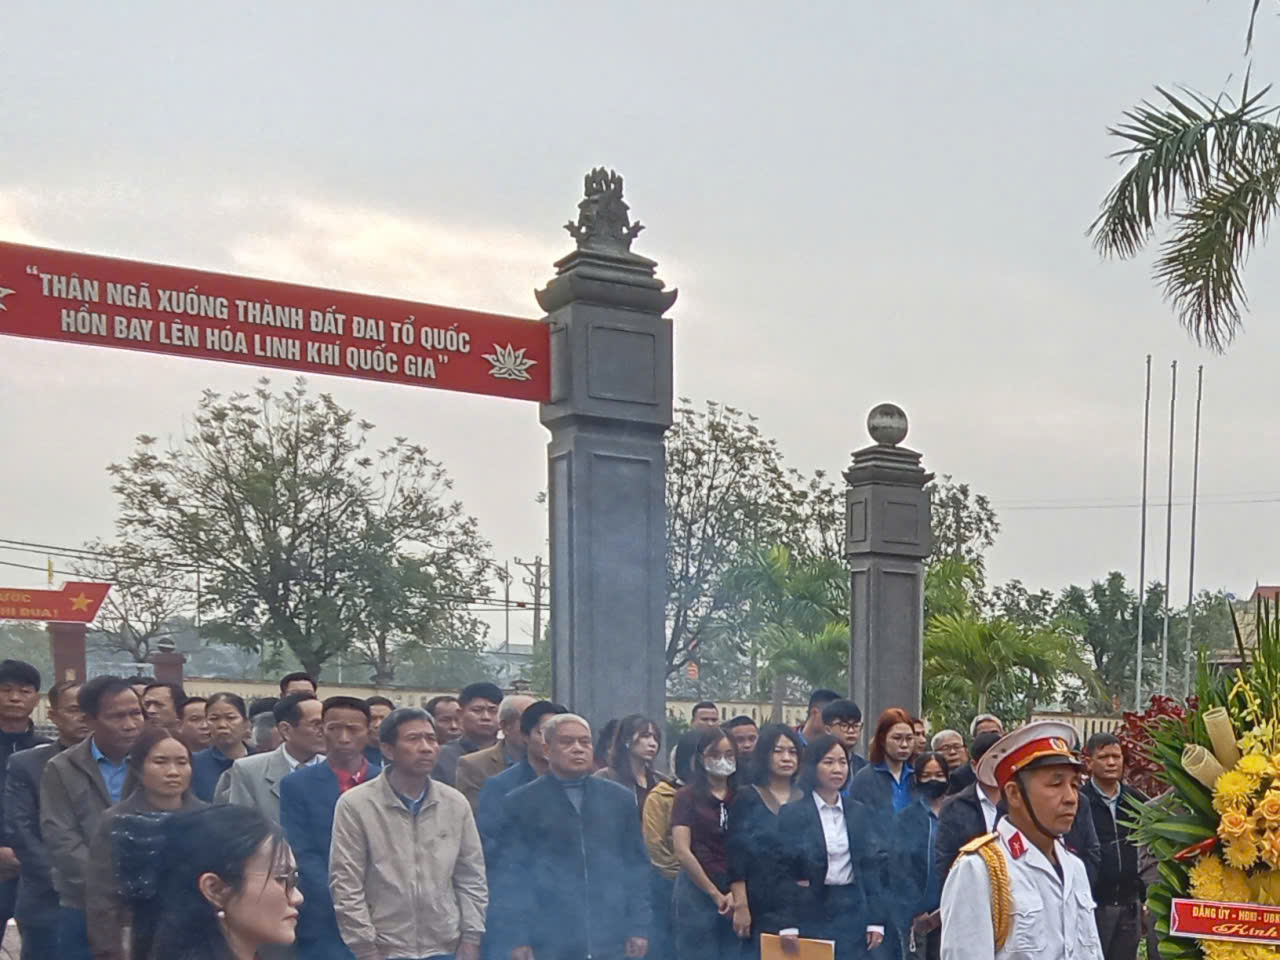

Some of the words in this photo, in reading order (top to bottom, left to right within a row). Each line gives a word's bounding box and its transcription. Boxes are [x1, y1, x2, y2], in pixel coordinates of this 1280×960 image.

[60, 302, 107, 336] HỒN
[114, 316, 154, 342] BAY
[159, 318, 199, 347] LÊN
[206, 325, 249, 354] HÓA
[254, 334, 300, 361] LINH
[307, 340, 340, 366] KHÍ
[346, 343, 398, 373] QUỐC
[106, 282, 152, 309] NGÃ
[157, 285, 229, 320] XUỐNG
[235, 299, 304, 330] THÀNH
[309, 305, 346, 335] ĐẤT
[352, 315, 385, 341] ĐAI
[390, 315, 416, 345] TỔ
[420, 323, 471, 353] QUỐC
[1192, 904, 1216, 919] ĐẢNG
